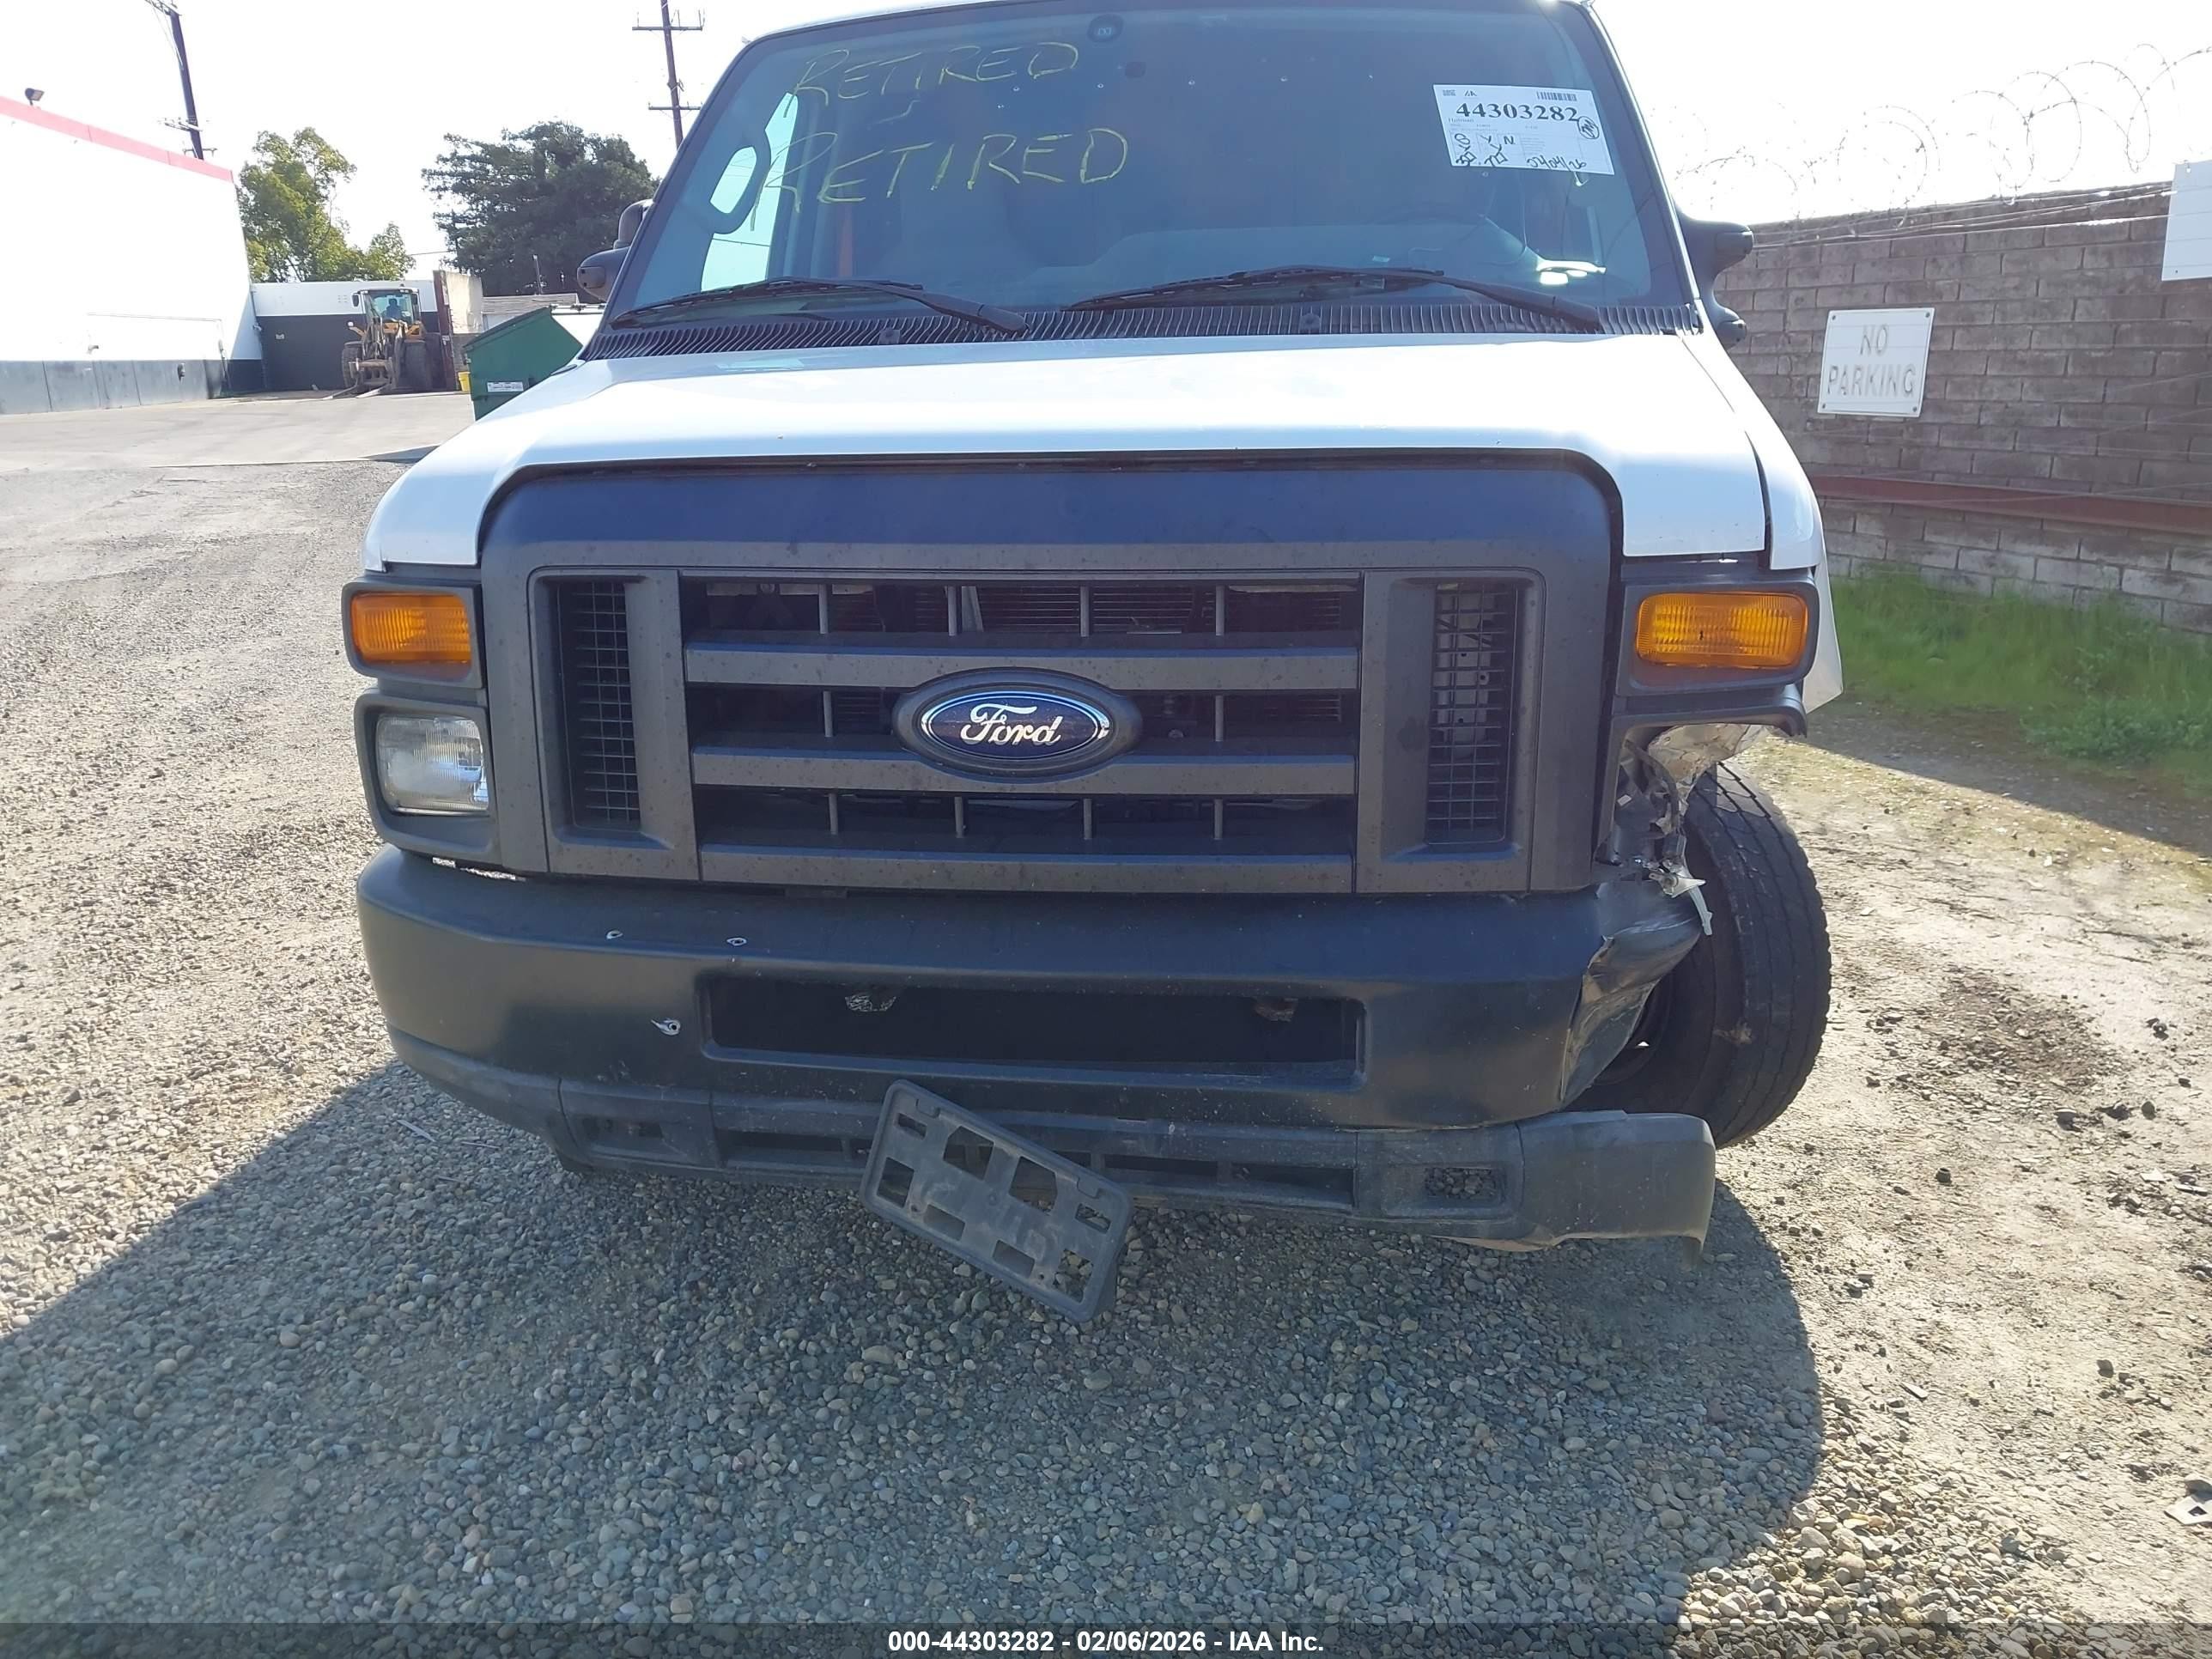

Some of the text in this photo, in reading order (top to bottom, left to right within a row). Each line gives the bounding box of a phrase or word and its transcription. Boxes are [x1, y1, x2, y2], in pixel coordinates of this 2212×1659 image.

[783, 41, 1079, 118] RETIRED
[1456, 102, 1579, 122] 44303282
[750, 128, 1129, 232] RETIRED
[1860, 324, 1888, 356] NO
[1826, 363, 1916, 398] PARKING
[960, 703, 1063, 744] Ford
